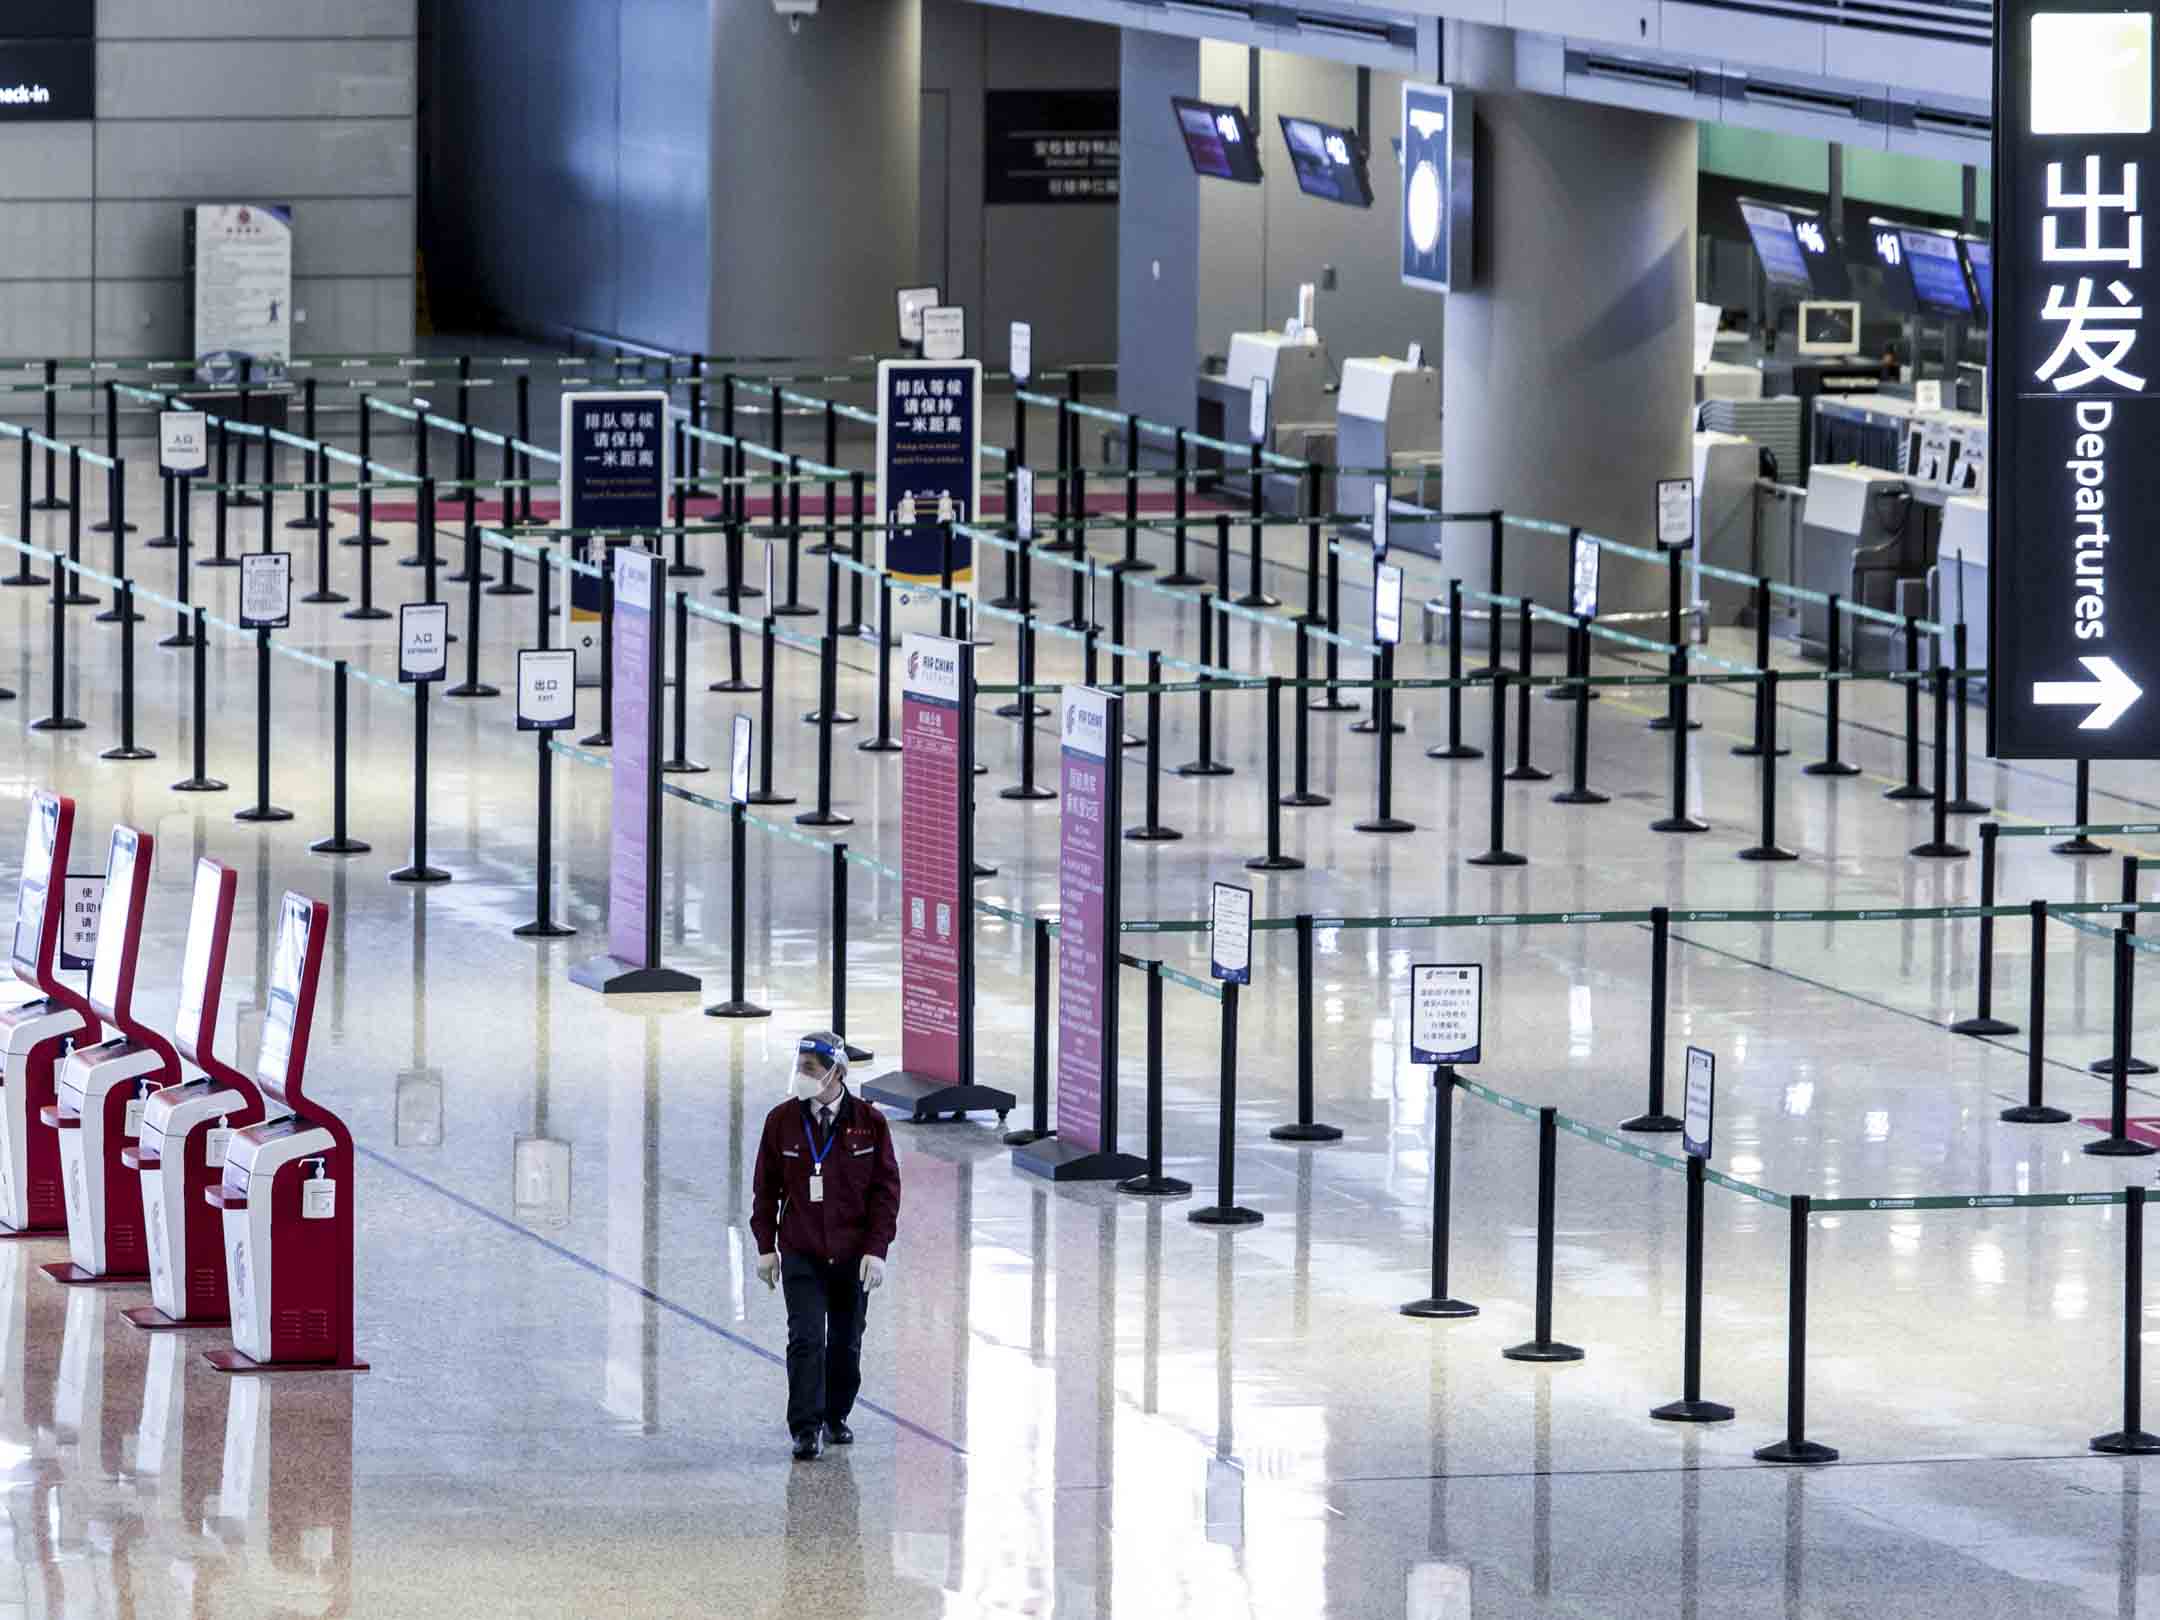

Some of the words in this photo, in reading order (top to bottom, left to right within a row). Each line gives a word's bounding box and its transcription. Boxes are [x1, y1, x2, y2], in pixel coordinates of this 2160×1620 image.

[2034, 155, 2147, 392] 出发
[895, 379, 963, 397] 排队等候
[904, 397, 954, 415] 请保持
[585, 412, 655, 430] 排队等候
[895, 415, 963, 433] 一米距离
[593, 431, 645, 448] 请保持
[583, 450, 655, 467] 一米距离
[2066, 401, 2112, 640] Departures
[414, 632, 434, 645] 入口
[534, 679, 558, 691] 出口
[75, 901, 101, 914] 自助
